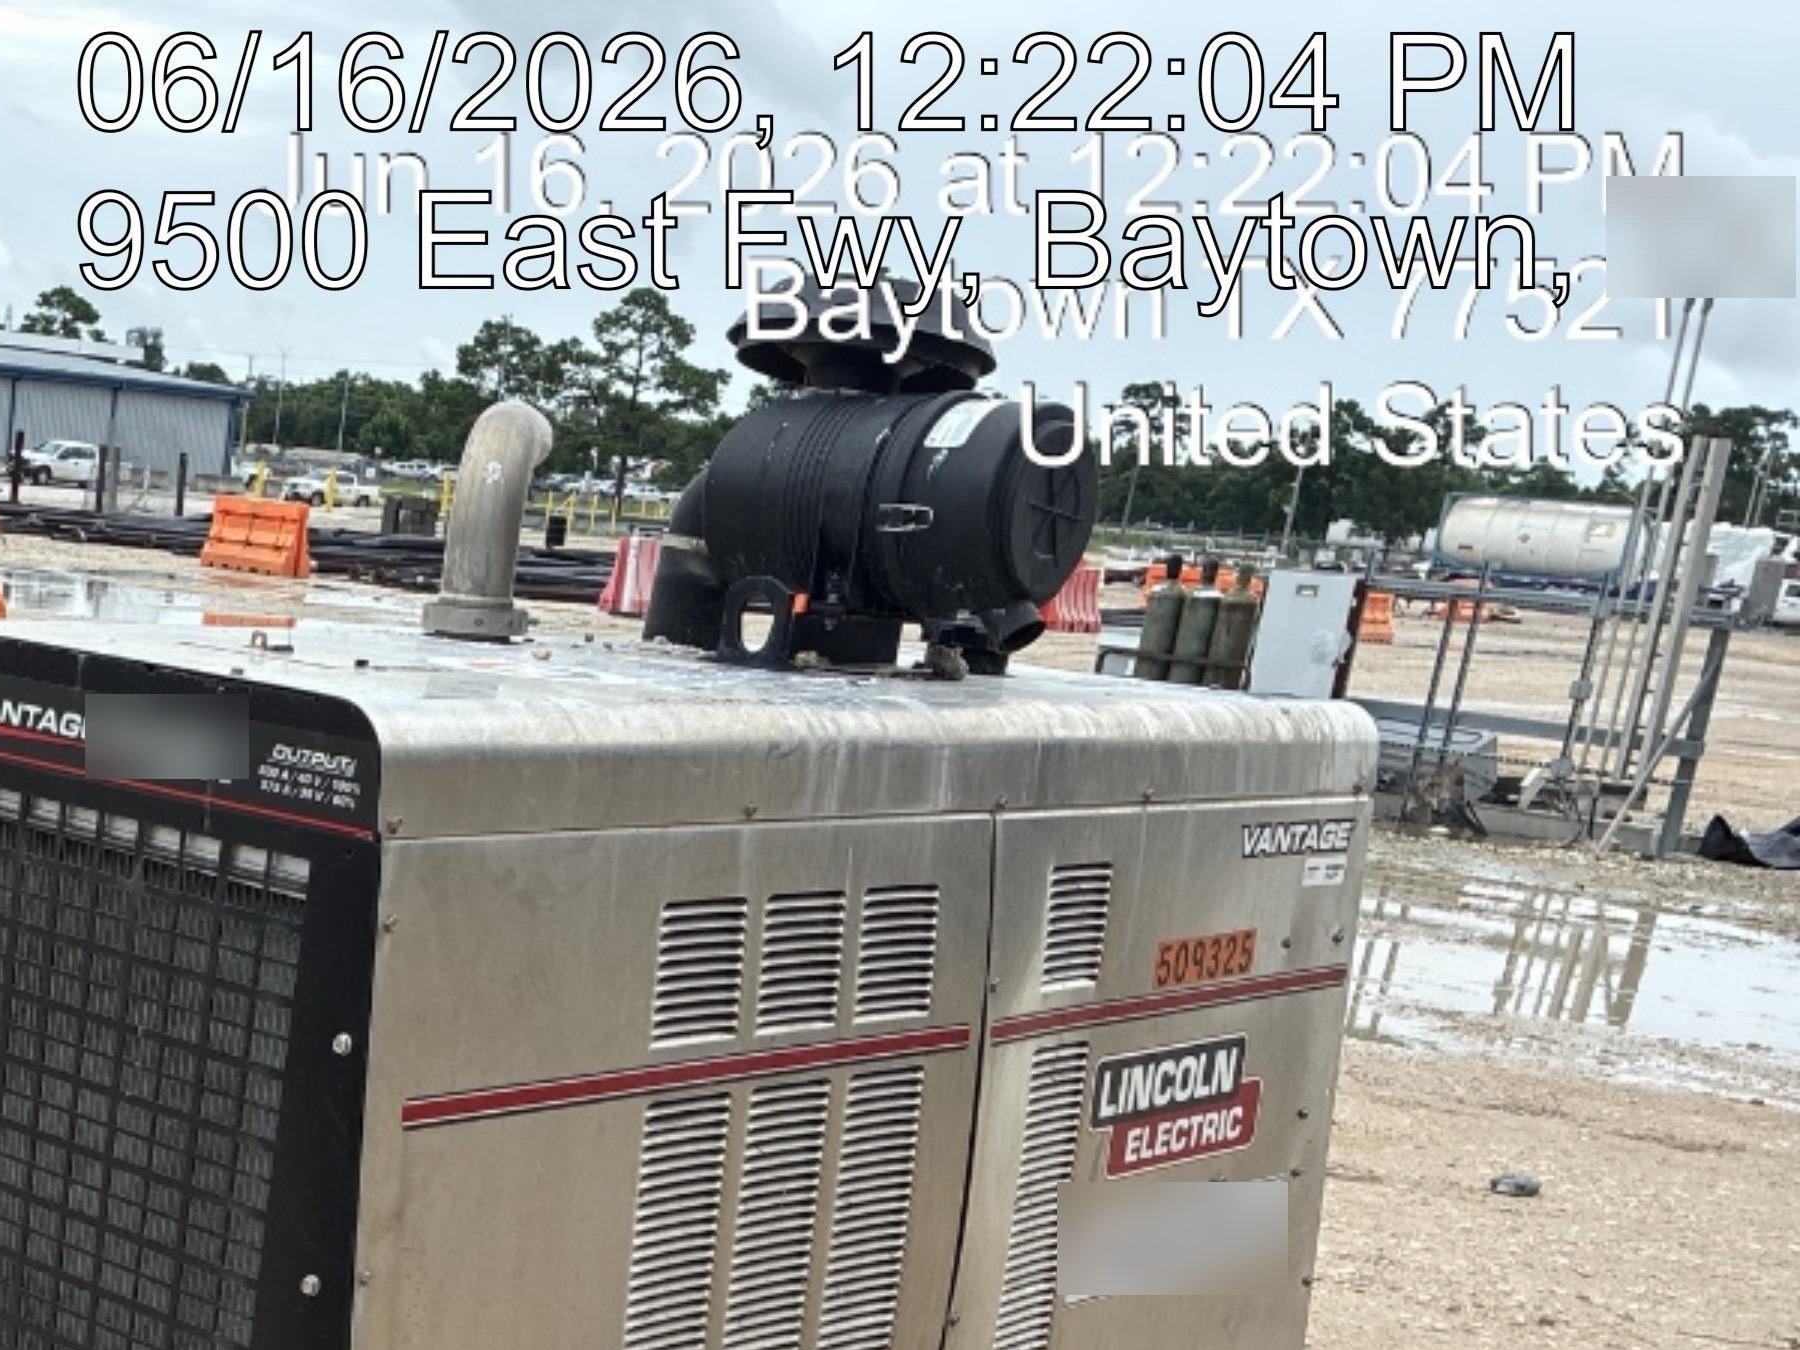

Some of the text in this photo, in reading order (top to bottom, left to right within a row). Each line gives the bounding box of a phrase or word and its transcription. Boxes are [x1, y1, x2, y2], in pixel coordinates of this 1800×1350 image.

[1242, 819, 1354, 858] VANTAGE
[1155, 932, 1257, 987] 509325
[1099, 1046, 1240, 1119] LINCOLN
[1123, 1106, 1245, 1163] ELECTRIC
